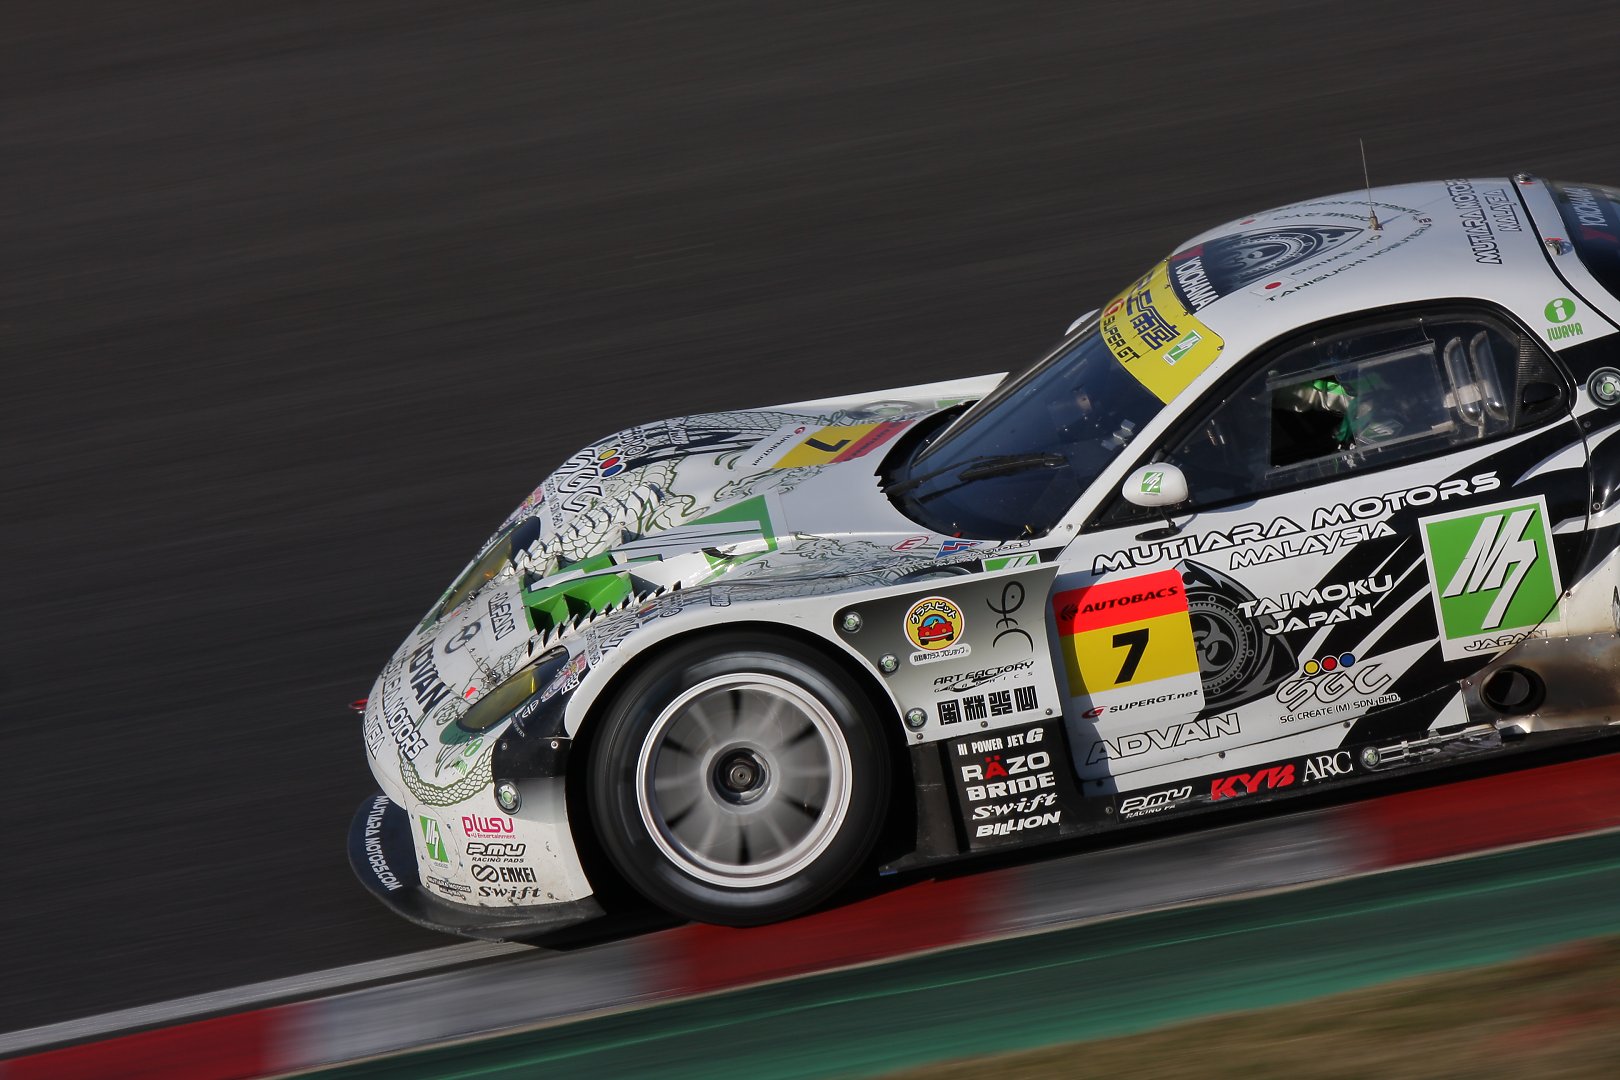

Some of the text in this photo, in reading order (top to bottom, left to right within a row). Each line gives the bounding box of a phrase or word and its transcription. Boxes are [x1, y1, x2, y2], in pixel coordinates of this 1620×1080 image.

[1175, 255, 1220, 312] YOKOHAMA
[1265, 258, 1368, 302] TANIGUCHI
[1103, 315, 1142, 363] SUPER GT
[1546, 322, 1584, 341] IWAYA
[805, 438, 852, 453] 7
[1092, 471, 1501, 576] MUTIARA MOTORS
[1229, 520, 1398, 570] MALAYSIA
[1081, 585, 1179, 615] AUTOBACS
[1238, 575, 1395, 620] TAIMOKU
[488, 591, 516, 642] JAPAN
[1264, 602, 1374, 636] JAPAN
[1112, 628, 1150, 685] 7
[1463, 629, 1549, 652] JAPAN
[409, 637, 452, 715] ADVAN
[933, 660, 1035, 686] ART FACTORY
[1276, 662, 1393, 713] SGC
[1109, 689, 1199, 714] SUPERGT.net
[1279, 714, 1295, 724] SG
[1297, 706, 1333, 720] CREATE
[1335, 702, 1351, 713] (M)
[1378, 693, 1401, 705] BHD.
[386, 697, 429, 761] MOTORS
[957, 727, 1044, 756] HI POWER JET G
[1085, 712, 1241, 766] ADVAN
[961, 751, 1051, 783] RÄZO
[1210, 764, 1296, 801] KYB
[1302, 751, 1354, 783] ARC
[966, 771, 1056, 802] BRIDE
[976, 811, 1062, 838] BILLION
[1125, 807, 1162, 819] RACING
[364, 795, 404, 892] MUTIARA MOTORS.COM
[498, 867, 538, 883] ENKEI
